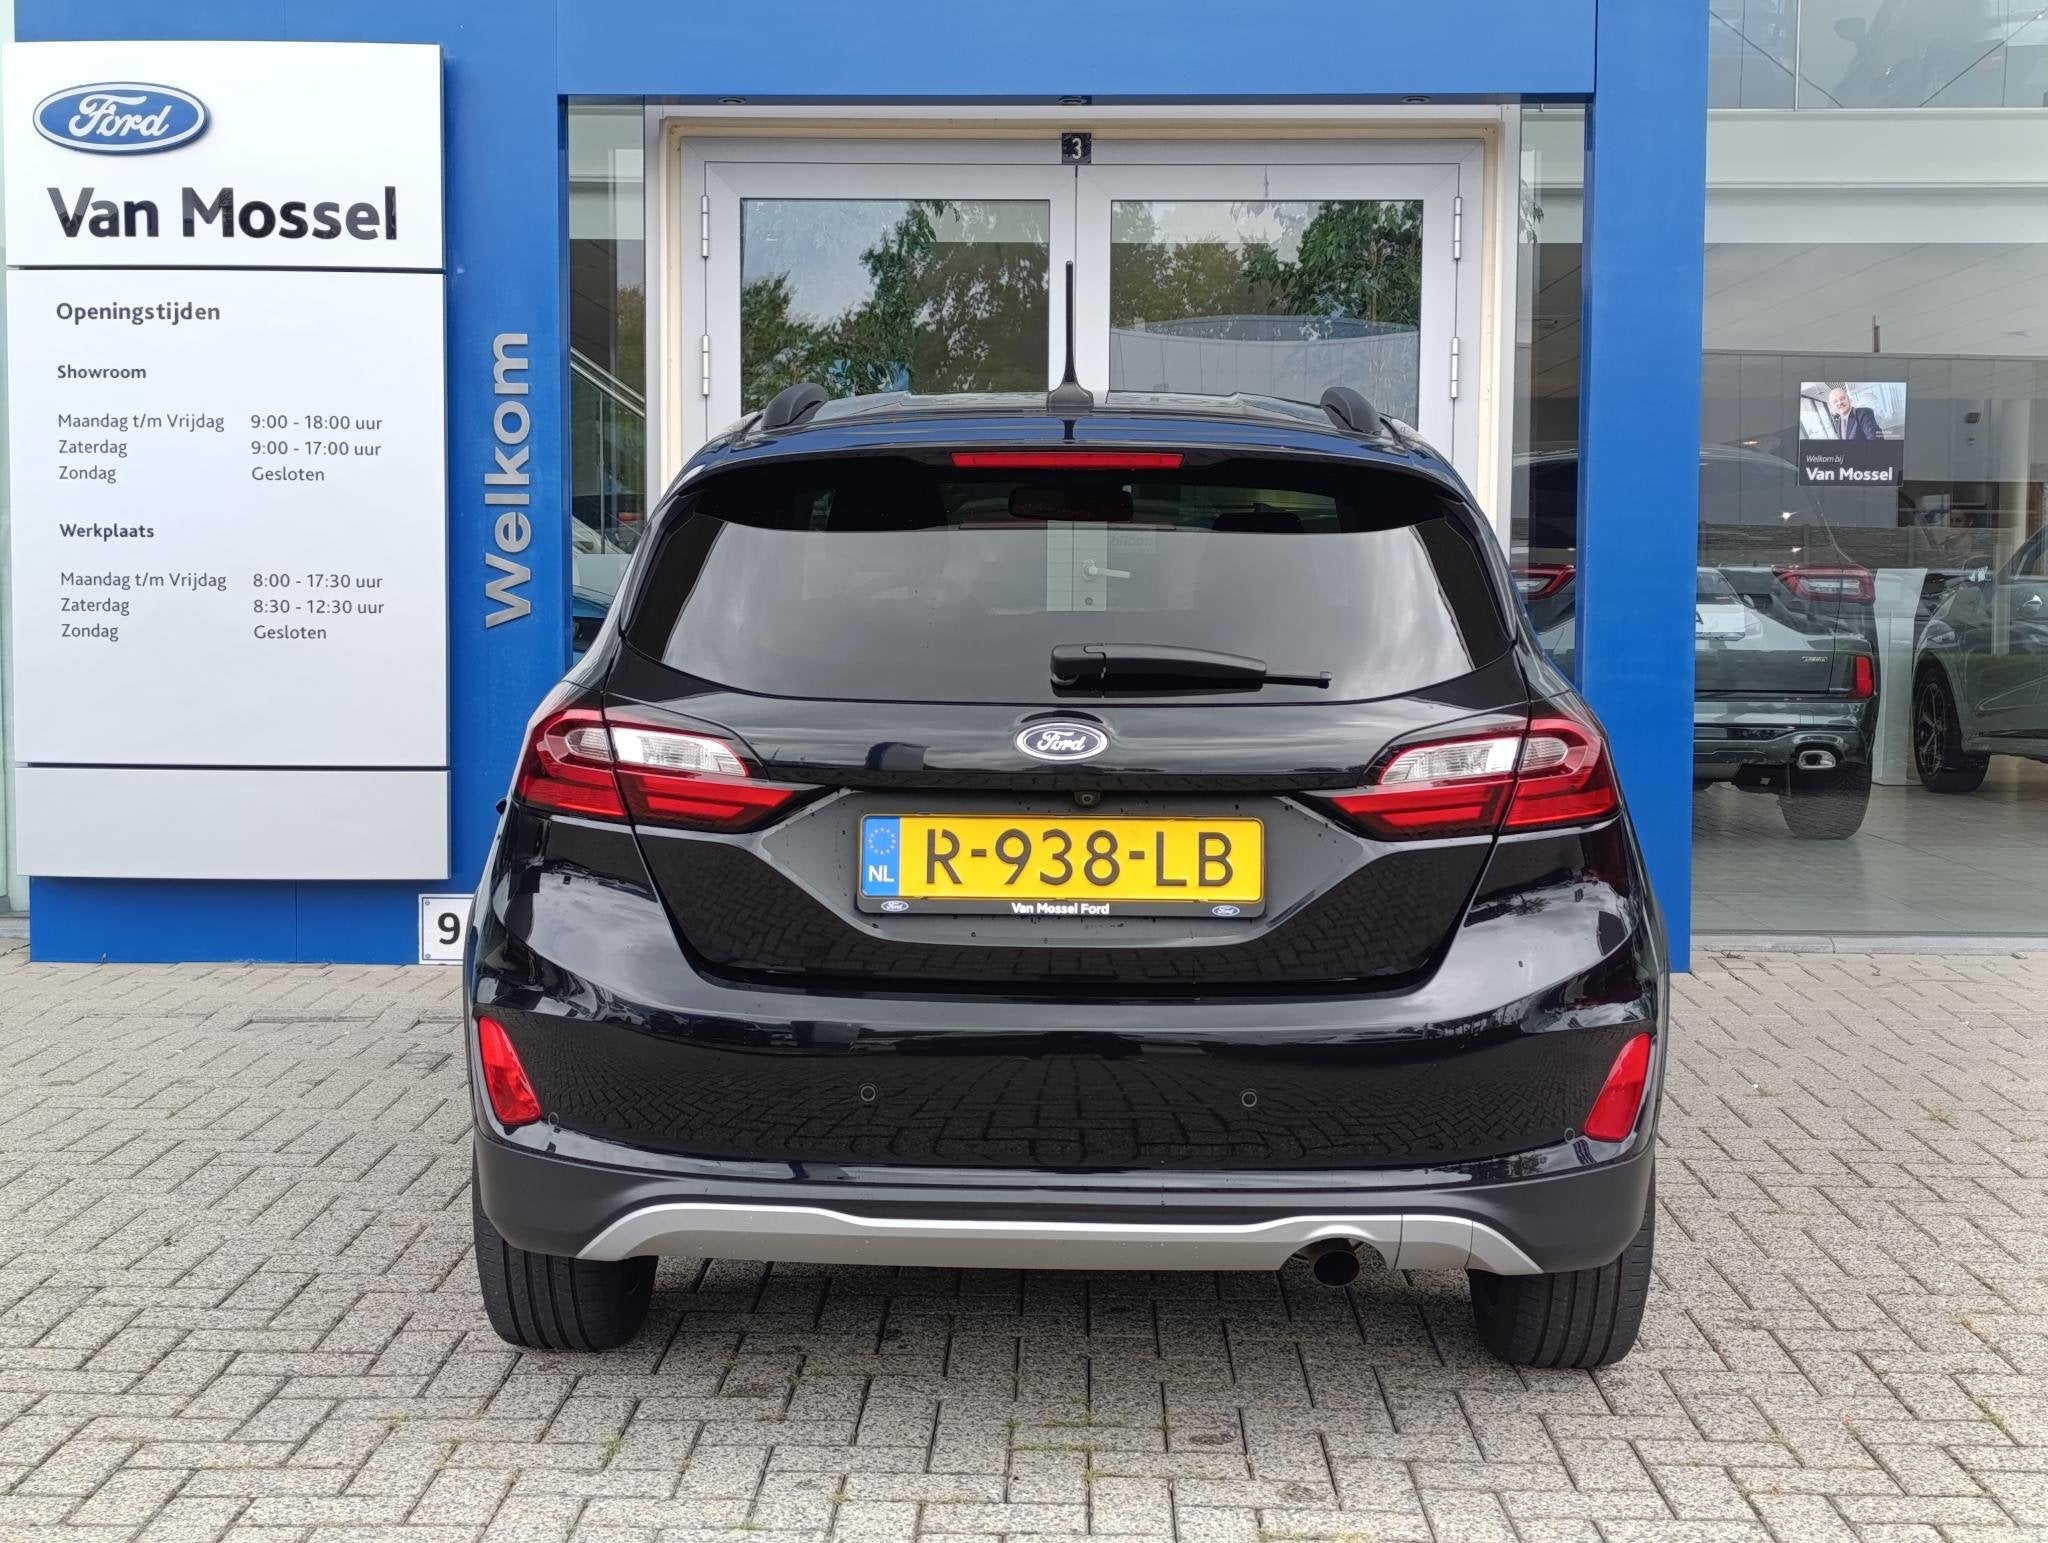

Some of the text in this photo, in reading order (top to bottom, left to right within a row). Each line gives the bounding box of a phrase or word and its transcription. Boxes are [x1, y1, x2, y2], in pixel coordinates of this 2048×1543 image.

[68, 93, 173, 137] Ford
[1072, 137, 1082, 160] 3
[47, 186, 398, 241] Van Mossel
[56, 301, 221, 326] Openingstijden
[57, 363, 147, 379] Showroom
[58, 412, 225, 433] Maandag t/m Vrijdag
[250, 414, 288, 430] 9:00
[304, 414, 351, 430] 18:00
[355, 418, 383, 431] uur
[58, 438, 128, 459] Zaterdag
[250, 440, 289, 456] 9:00
[304, 440, 350, 456] 17:00
[354, 444, 382, 457] uur
[1806, 455, 1845, 465] Welkom bij
[58, 464, 117, 485] Zondag
[251, 465, 325, 482] Gesloten
[484, 333, 531, 628] Welkom
[1805, 466, 1893, 481] Van Mossel
[59, 522, 155, 543] Werkplaats
[60, 571, 227, 592] Maandag t/m Vrijdag
[253, 573, 291, 589] 8:00
[306, 573, 351, 589] 17:30
[355, 577, 384, 590] uur
[60, 597, 130, 617] Zaterdag
[253, 599, 291, 615] 8:30
[306, 599, 353, 615] 12:30
[357, 603, 385, 615] uur
[61, 622, 119, 643] Zondag
[253, 624, 327, 641] Gesloten
[1037, 730, 1087, 751] Ford
[926, 828, 1234, 887] R-938-LB
[868, 866, 894, 883] NL
[1011, 902, 1110, 915] Van Mossel Ford
